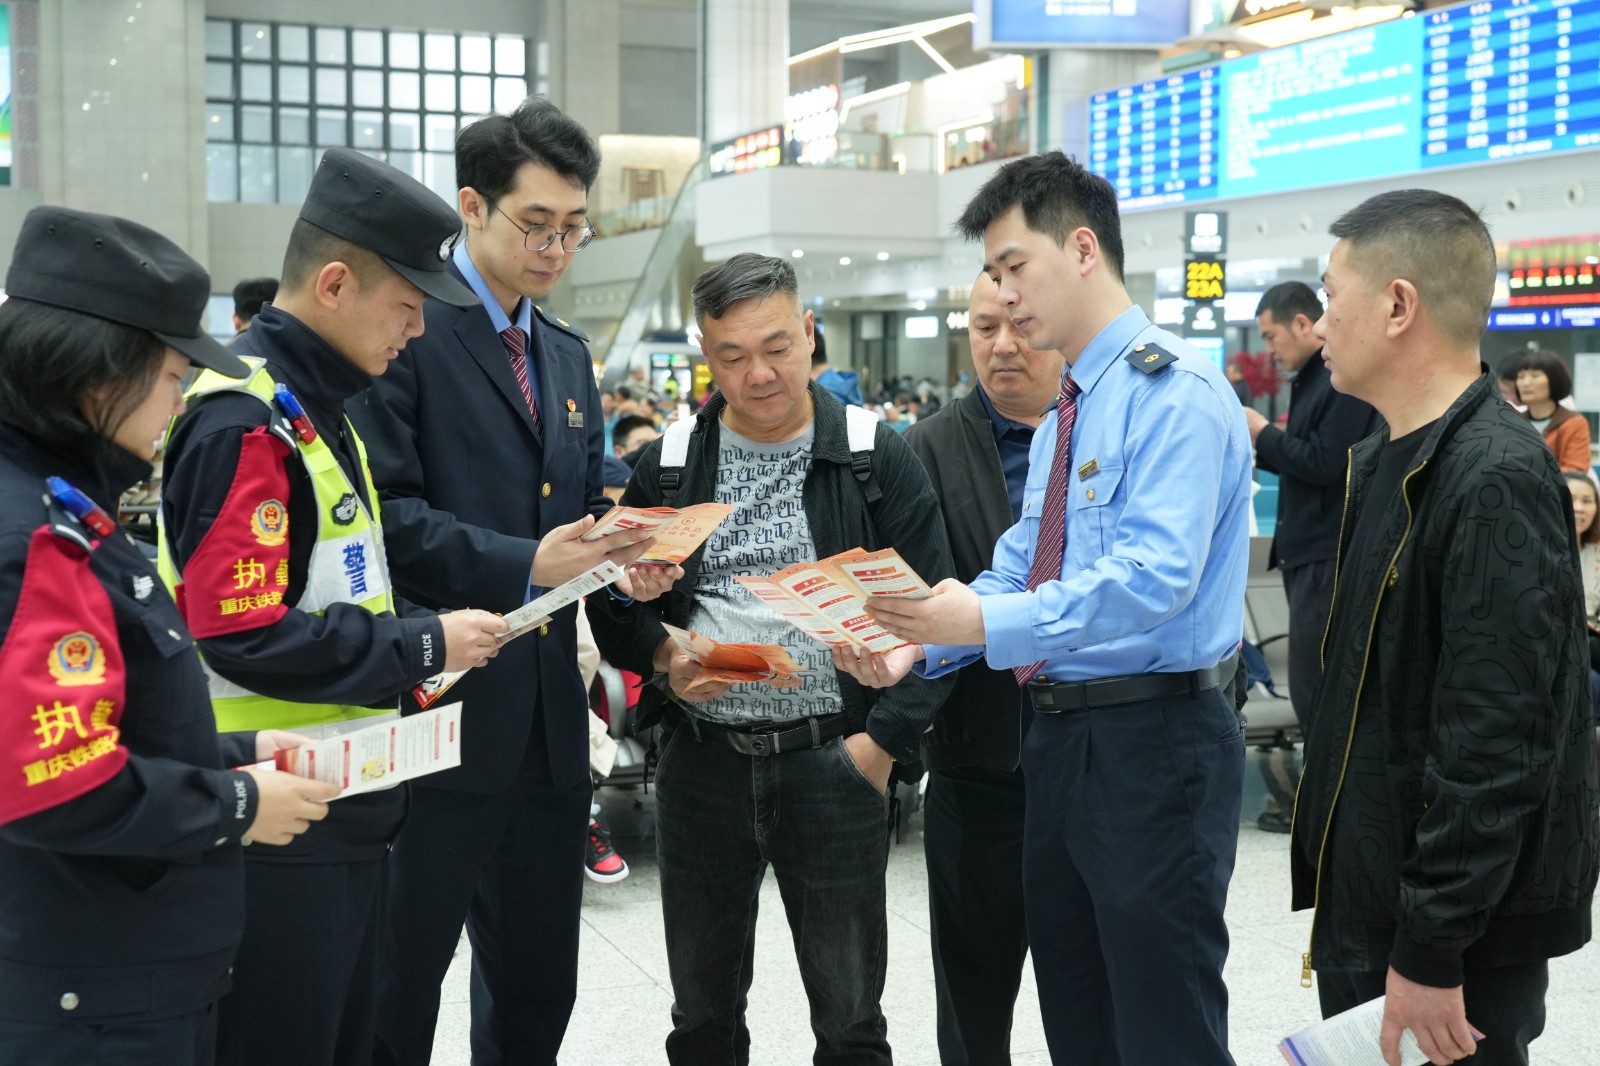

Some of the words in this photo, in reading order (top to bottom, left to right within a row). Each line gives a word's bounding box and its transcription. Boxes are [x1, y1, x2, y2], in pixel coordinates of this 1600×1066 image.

[1187, 262, 1224, 281] 22A
[422, 633, 433, 667] POLICE
[234, 779, 248, 820] POLICE
